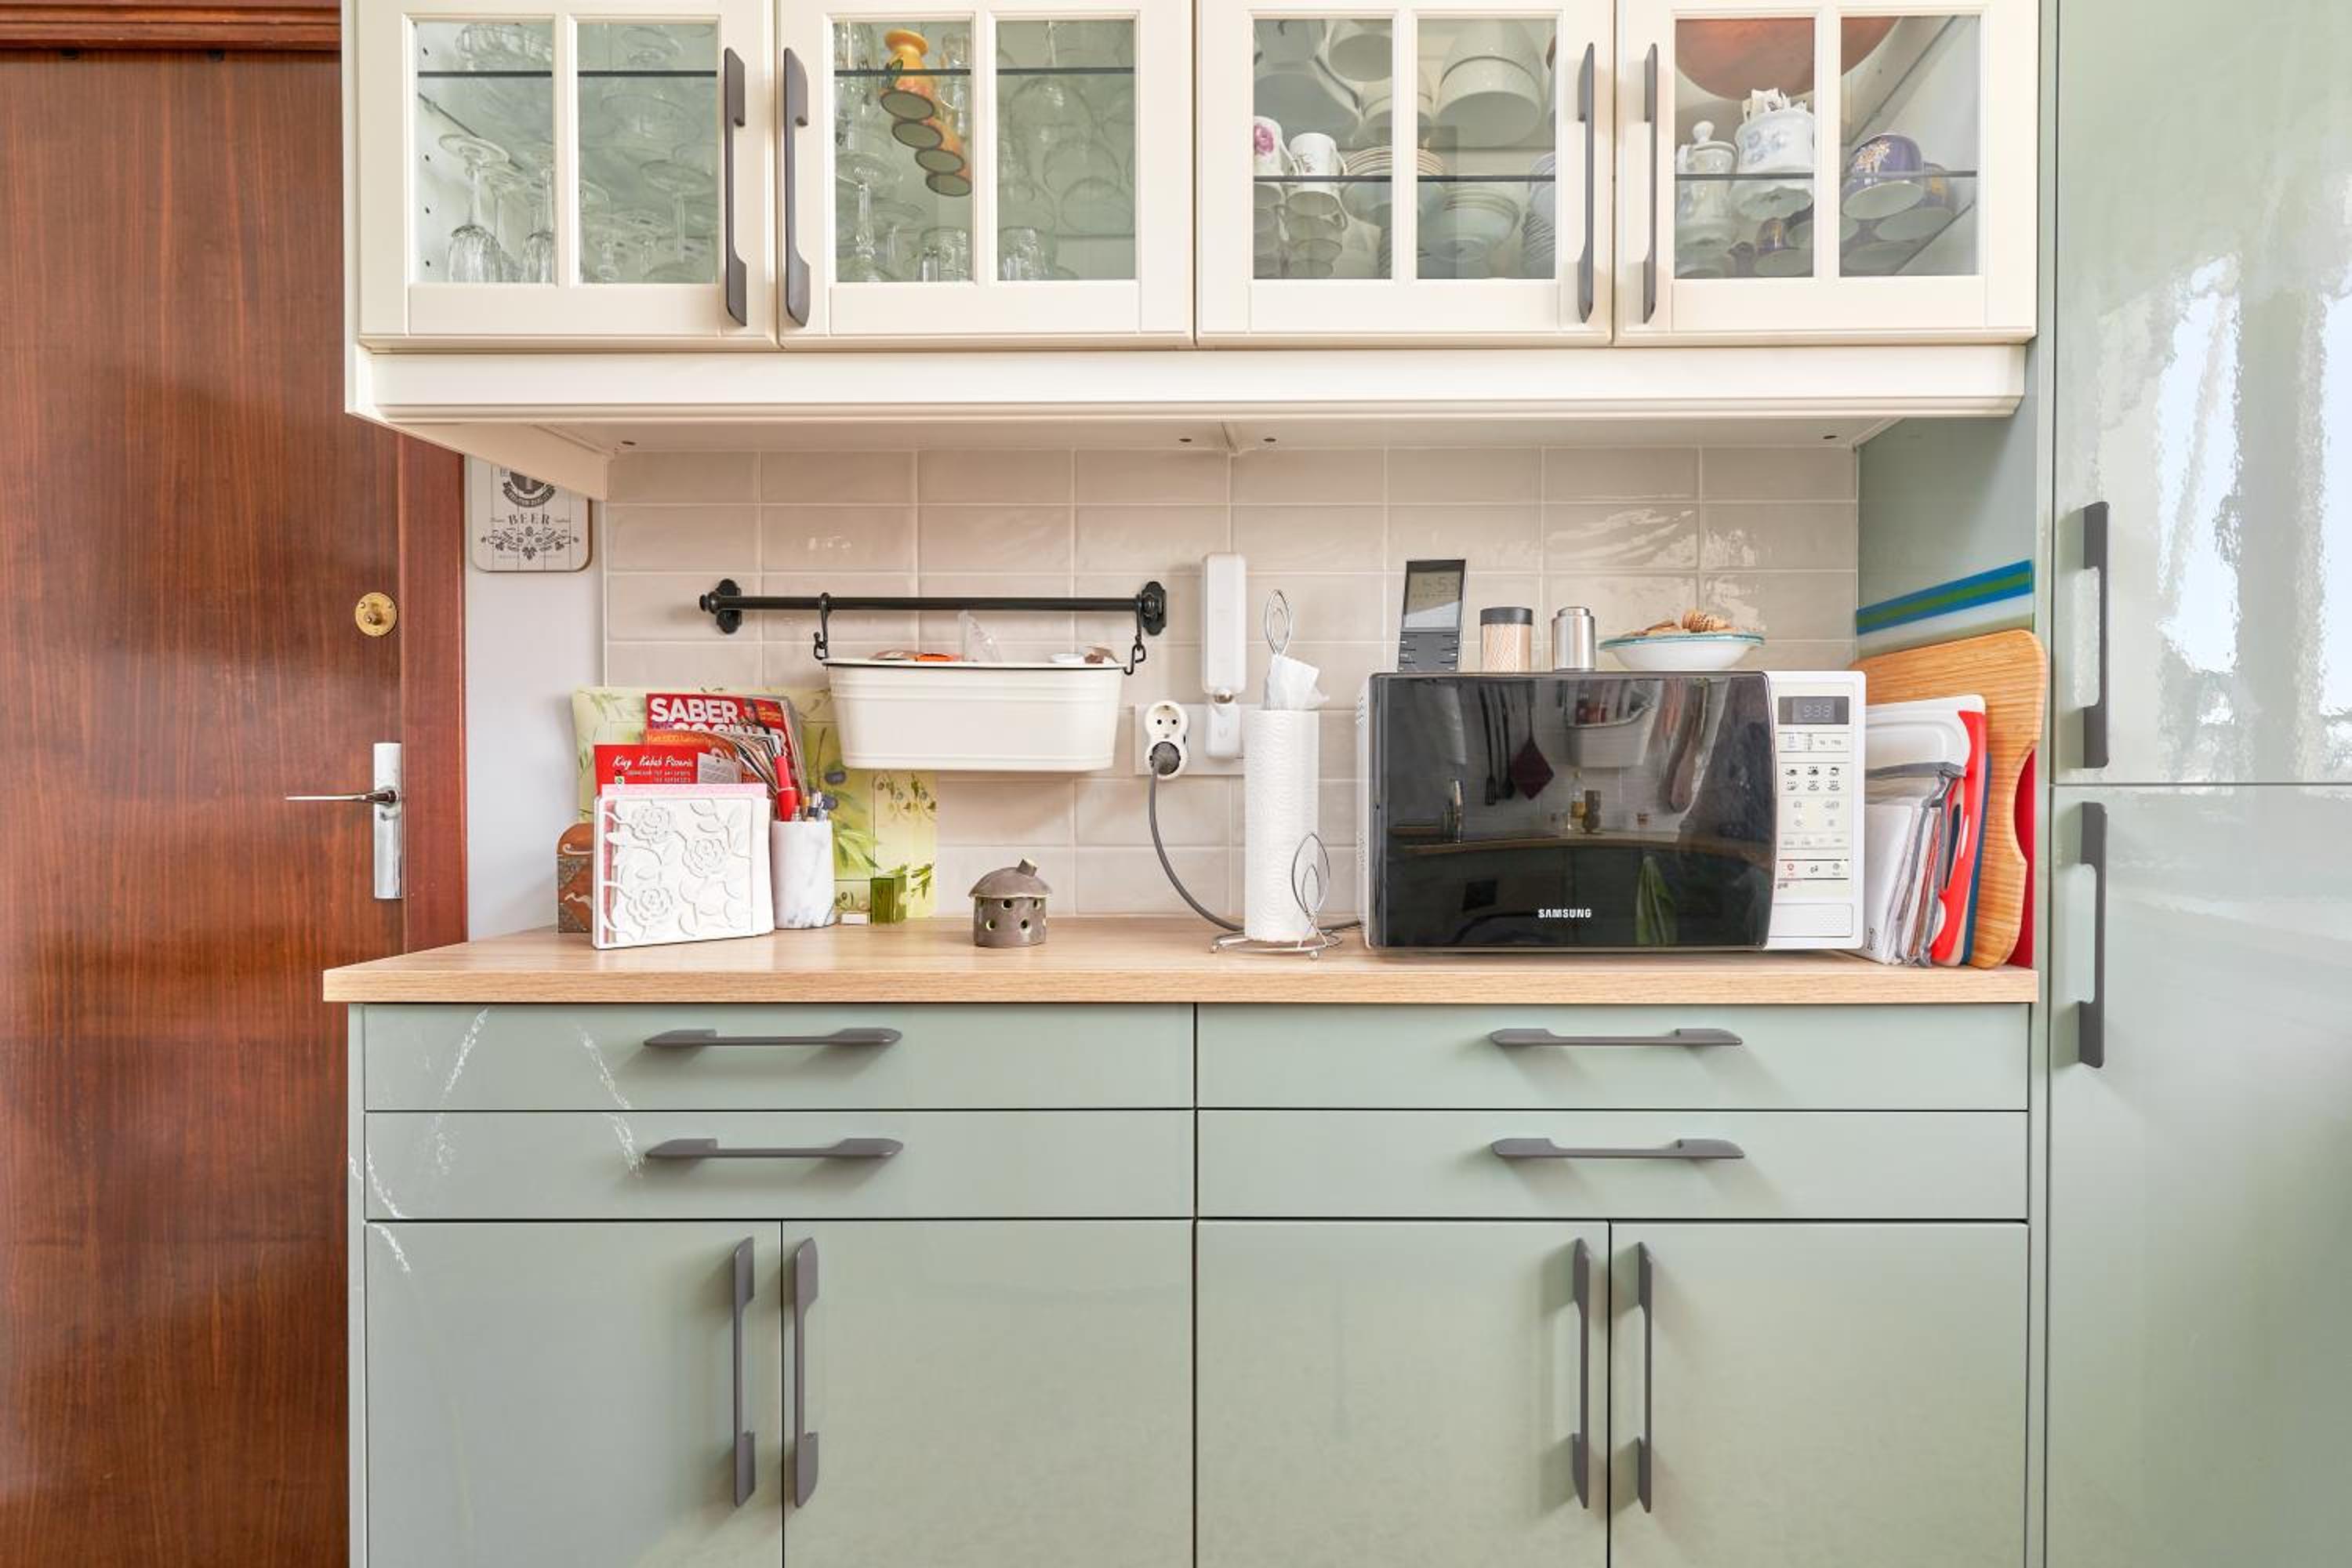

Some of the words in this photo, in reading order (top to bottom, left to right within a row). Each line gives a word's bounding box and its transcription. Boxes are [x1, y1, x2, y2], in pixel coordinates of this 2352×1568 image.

[509, 514, 550, 524] BEER
[650, 697, 738, 724] SABER
[612, 754, 632, 771] King
[1537, 909, 1592, 918] SAMSUNG
